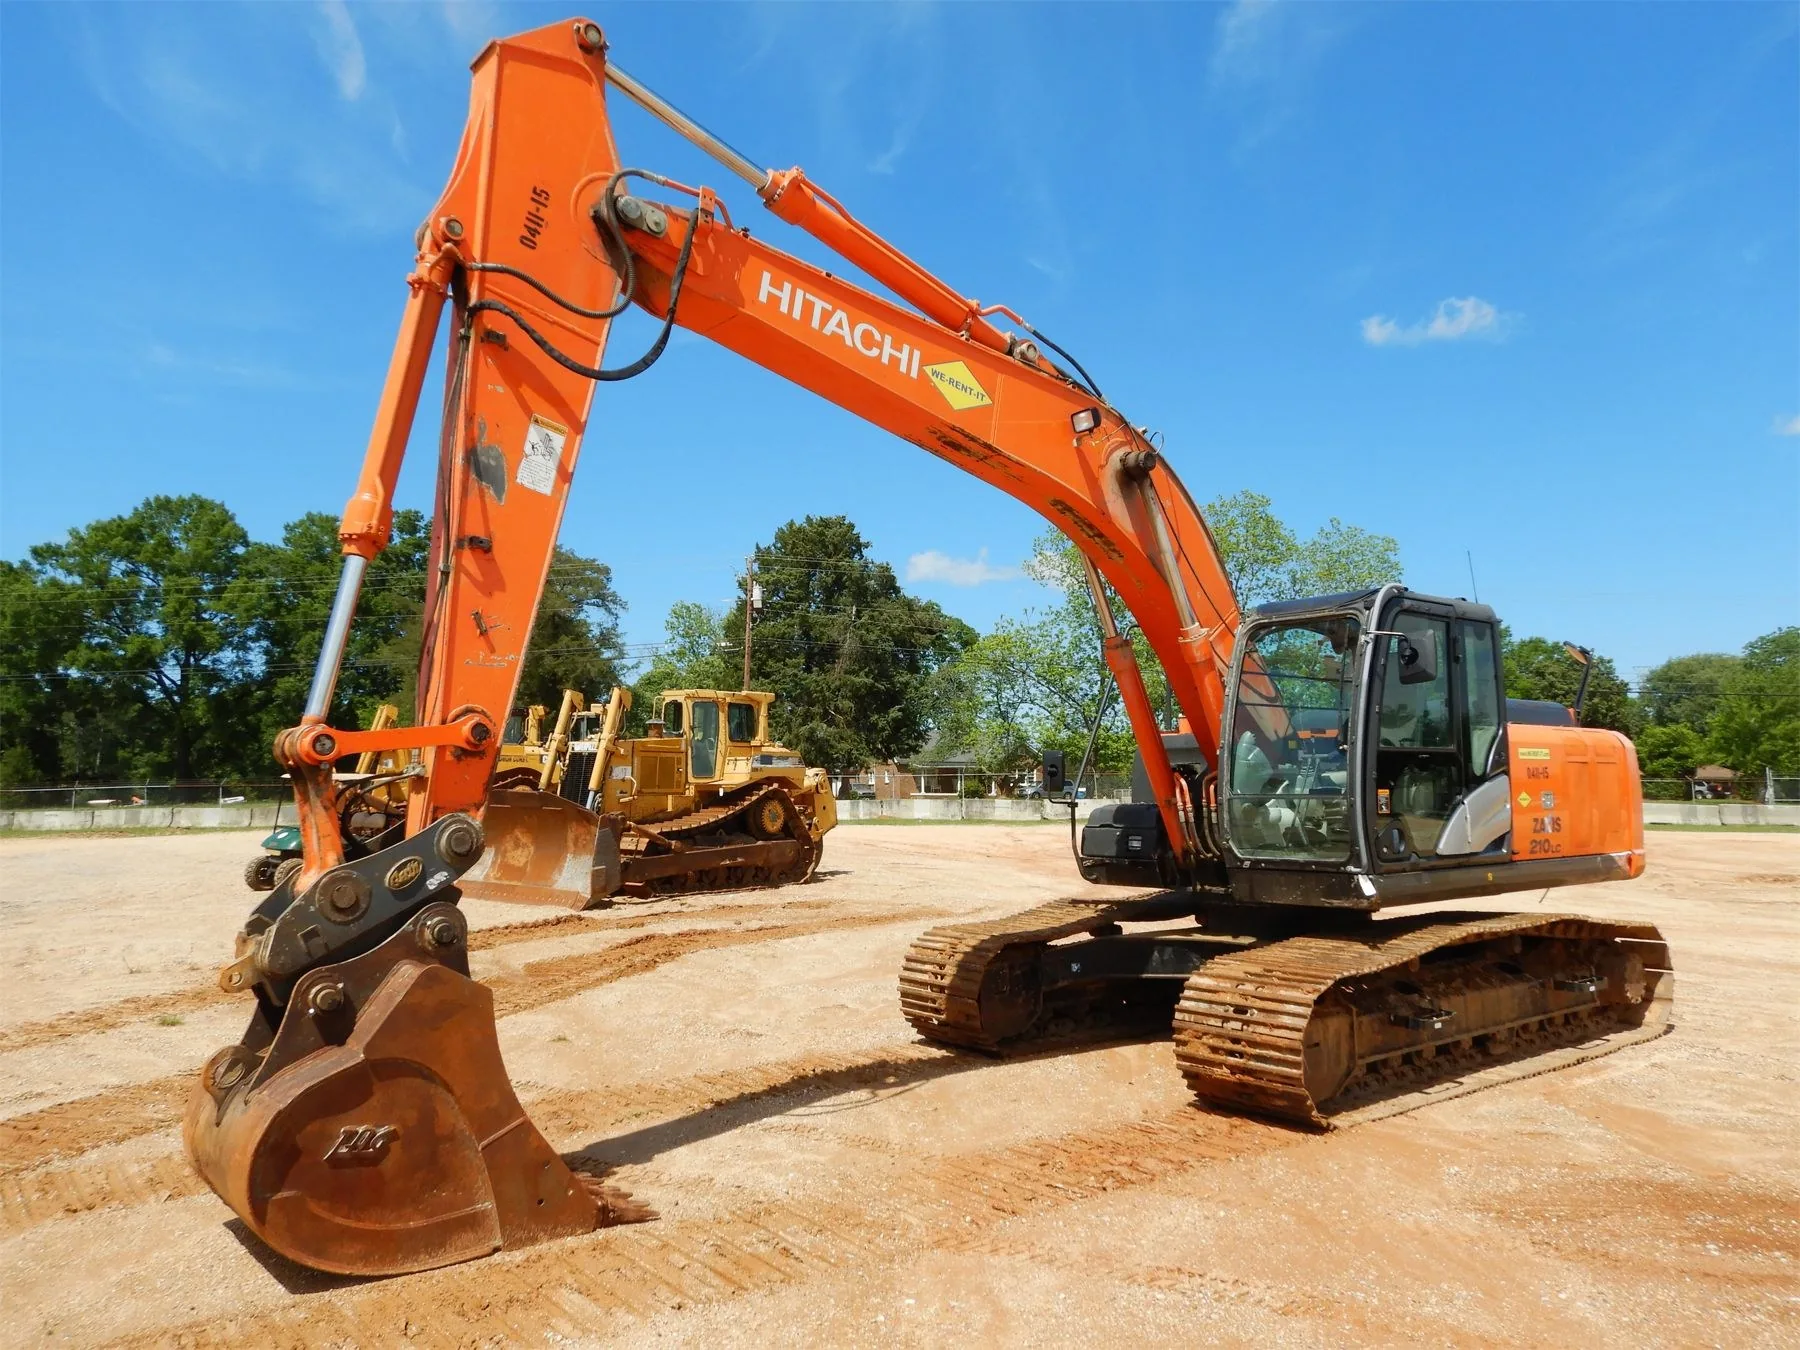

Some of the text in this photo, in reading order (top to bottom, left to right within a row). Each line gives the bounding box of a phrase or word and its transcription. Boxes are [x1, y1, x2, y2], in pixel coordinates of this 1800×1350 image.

[519, 185, 550, 250] 0411-15
[758, 270, 921, 380] HITACHI
[931, 367, 986, 402] WE-RENT-IT
